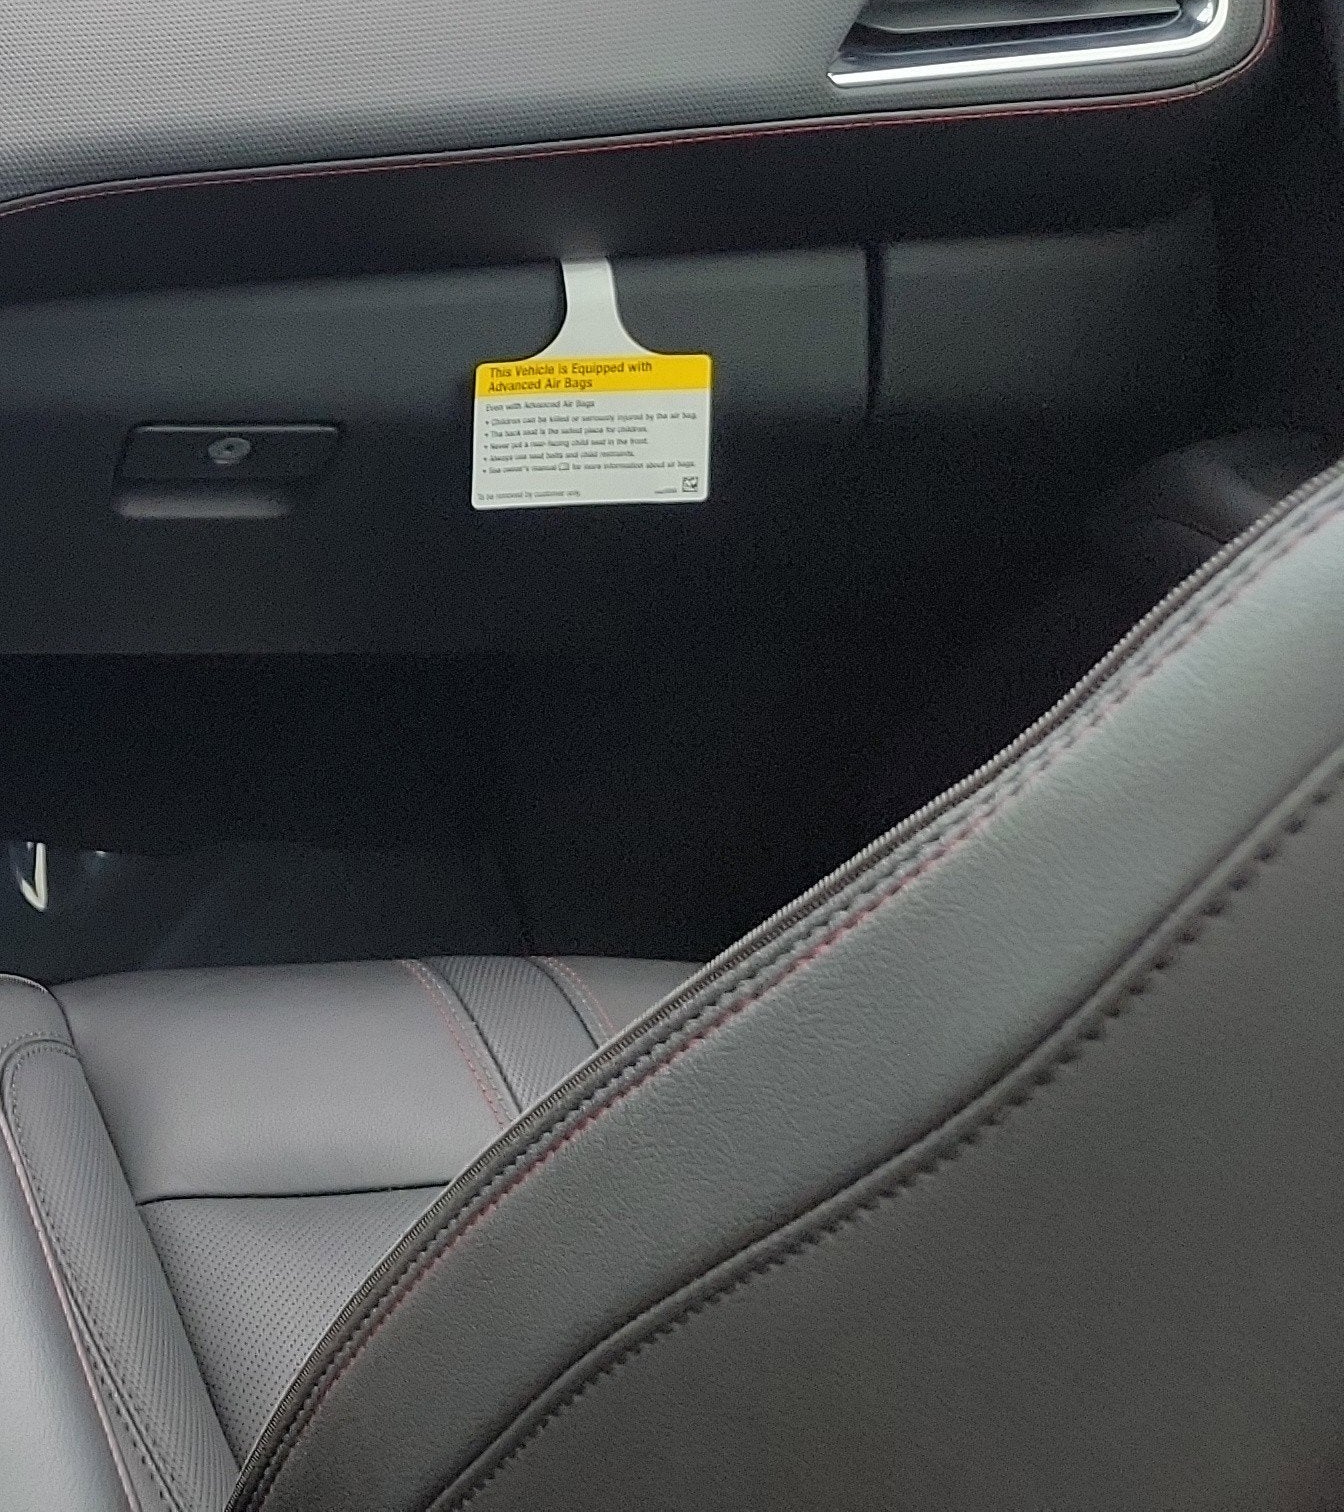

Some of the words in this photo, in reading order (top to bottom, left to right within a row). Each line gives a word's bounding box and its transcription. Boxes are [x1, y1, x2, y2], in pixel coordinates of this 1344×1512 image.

[490, 368, 512, 378] This
[515, 365, 555, 377] Vehicle
[558, 363, 568, 375] is
[572, 362, 625, 376] Equipped
[628, 361, 653, 373] with
[488, 379, 541, 393] Advanced
[545, 378, 562, 389] Air
[564, 377, 593, 390] Bags
